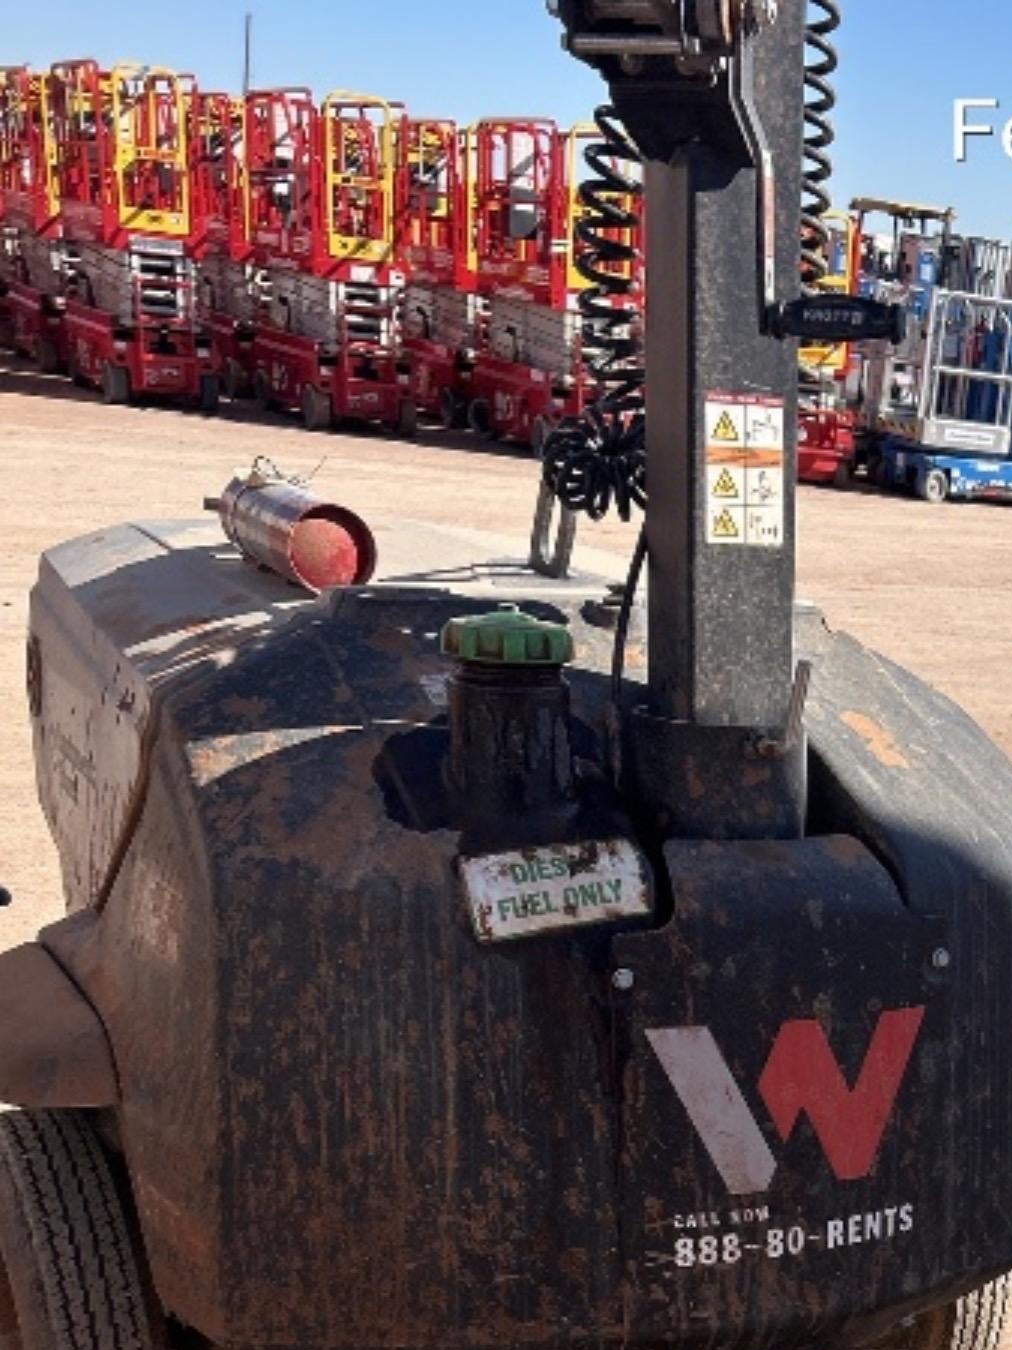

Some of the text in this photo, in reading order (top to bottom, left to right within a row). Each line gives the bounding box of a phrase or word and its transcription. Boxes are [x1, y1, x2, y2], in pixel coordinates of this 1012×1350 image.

[511, 855, 598, 887] DIES
[497, 878, 623, 922] FUEL ONLY
[674, 1202, 914, 1268] 888-80-RENTS
